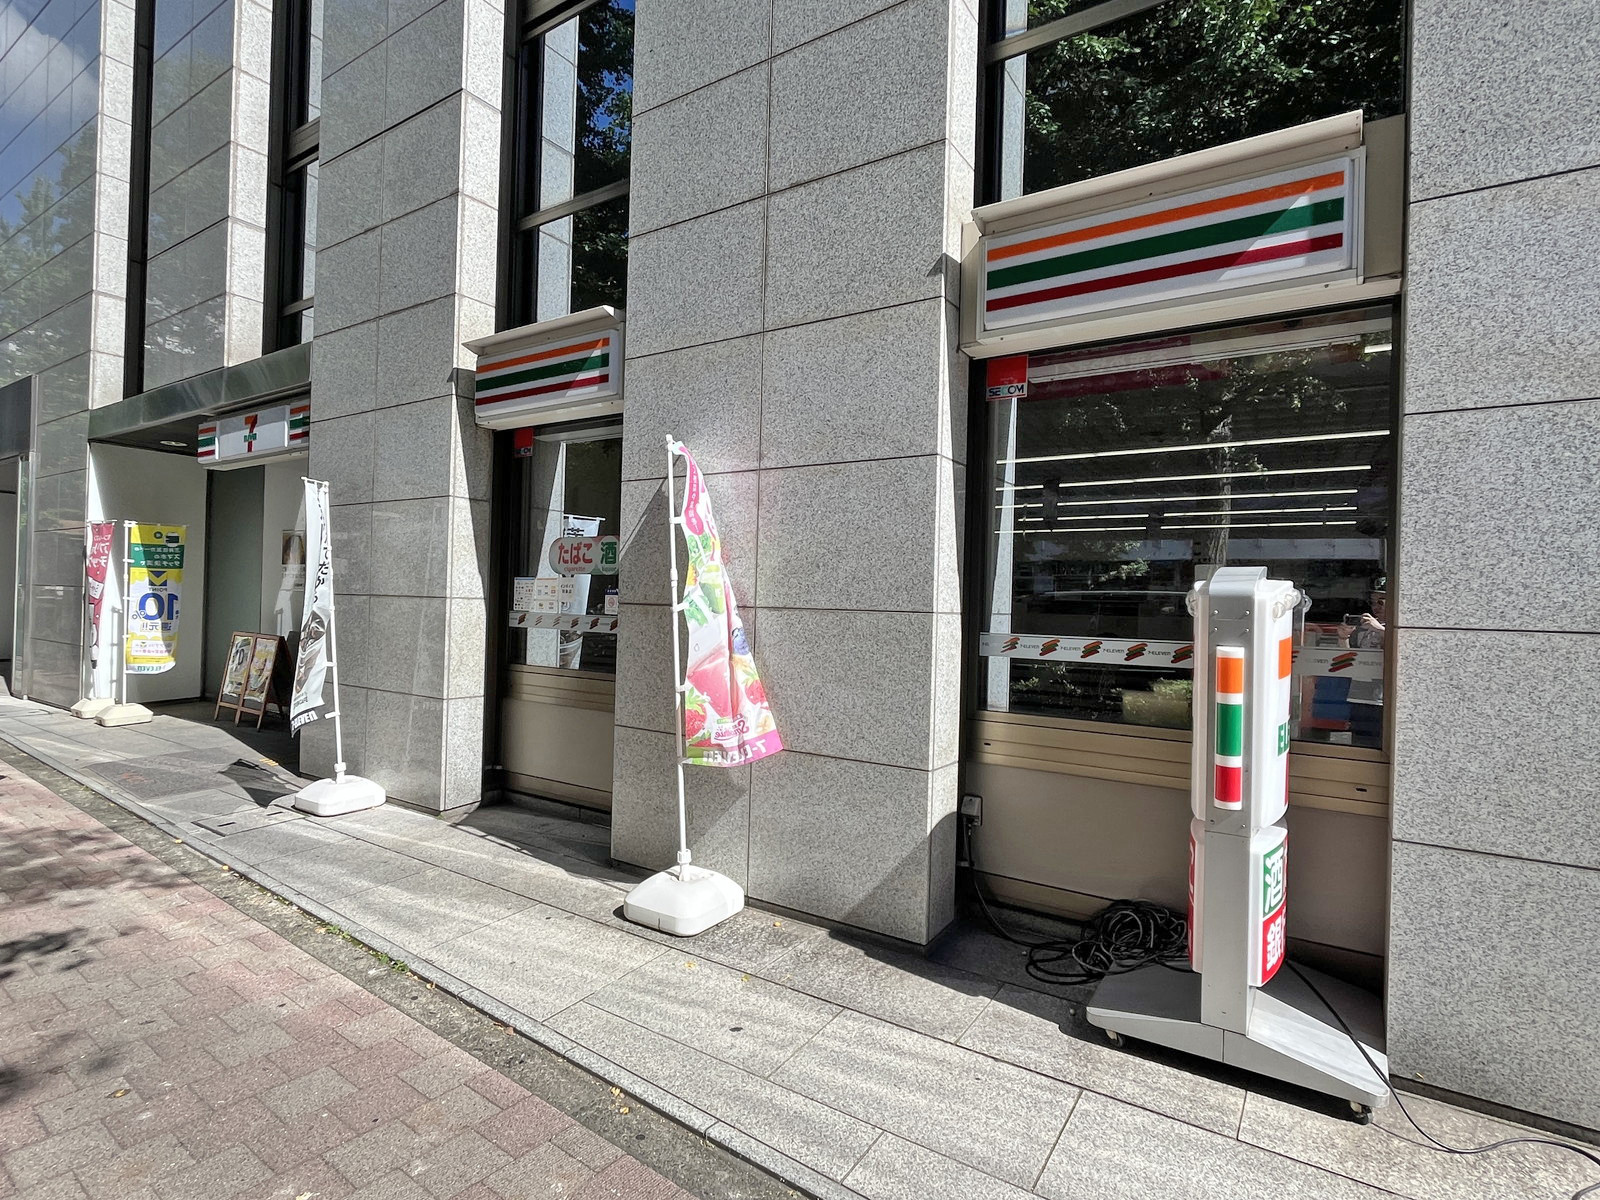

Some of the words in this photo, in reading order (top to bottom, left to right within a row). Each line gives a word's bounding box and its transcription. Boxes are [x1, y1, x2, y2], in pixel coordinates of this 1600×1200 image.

[988, 384, 1025, 397] SECOM
[557, 541, 593, 565] たばこ
[600, 541, 617, 564] 酒
[1265, 846, 1284, 914] 酒
